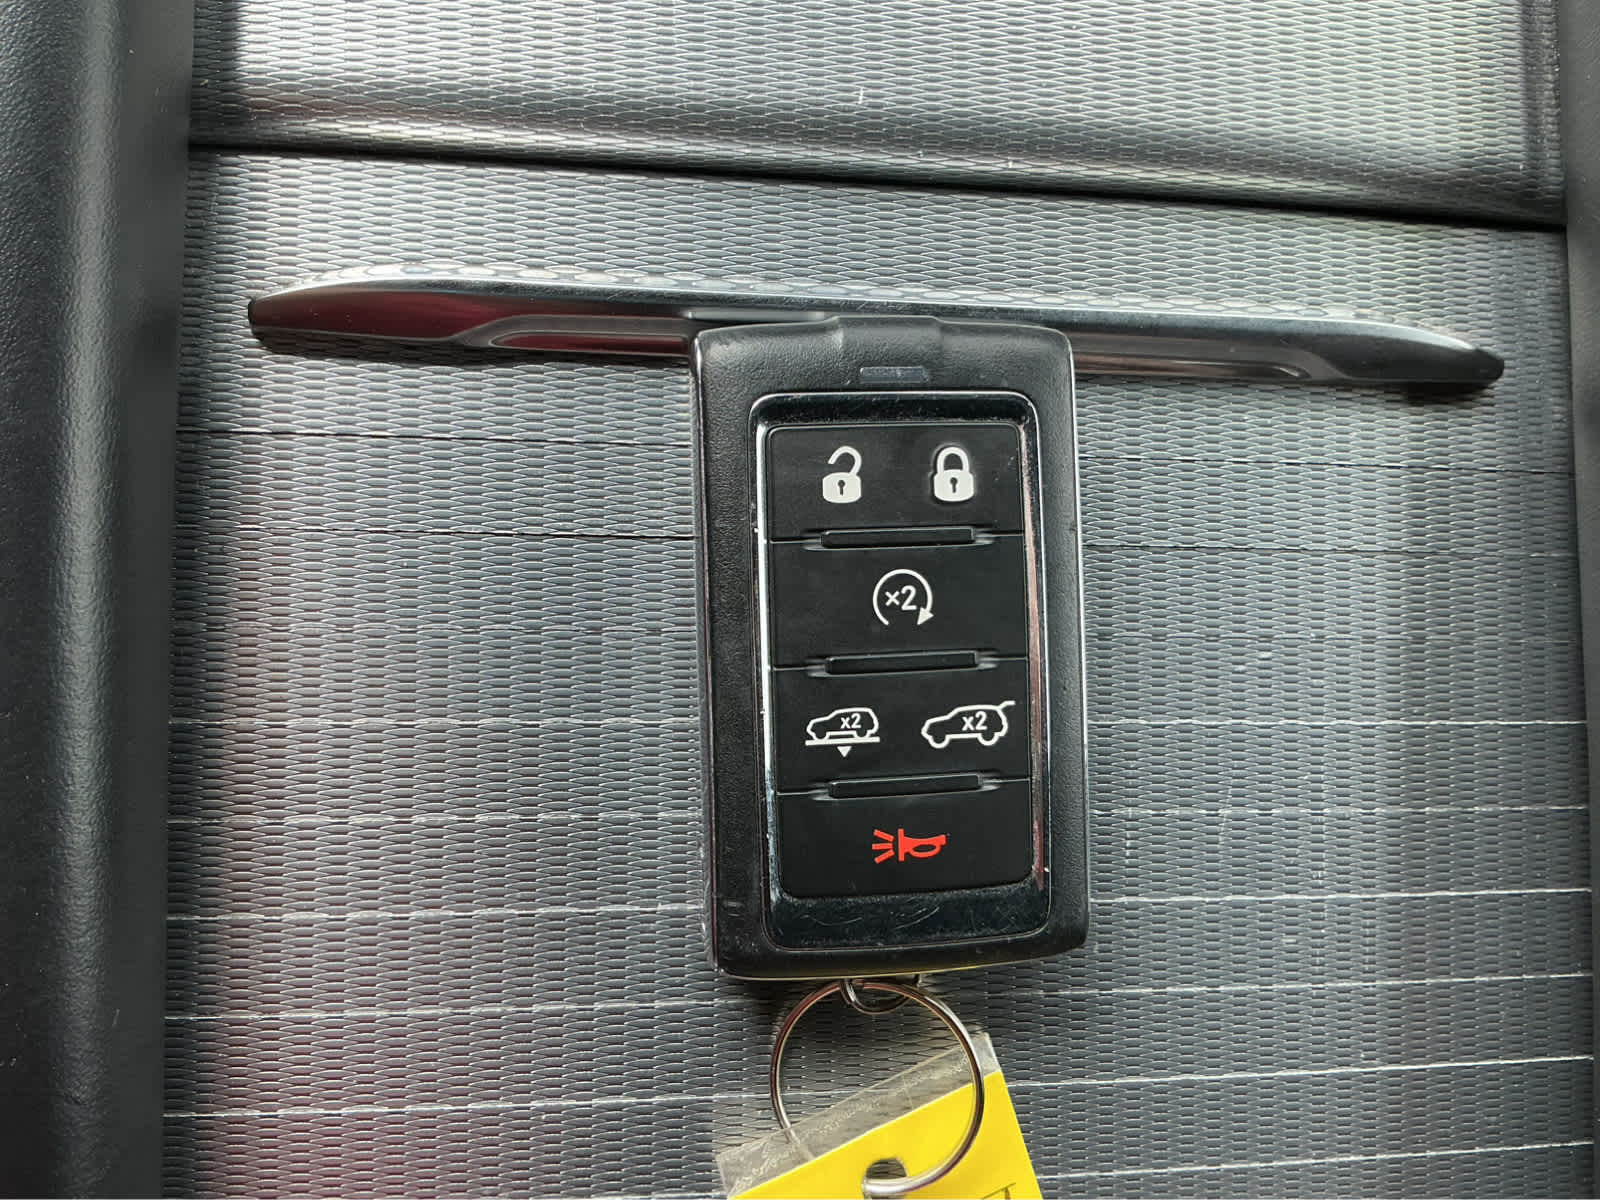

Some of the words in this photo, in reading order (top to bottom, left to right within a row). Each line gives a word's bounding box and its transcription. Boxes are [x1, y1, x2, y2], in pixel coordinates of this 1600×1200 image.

[885, 585, 917, 611] x2
[840, 712, 862, 729] x2
[961, 710, 988, 731] x2
